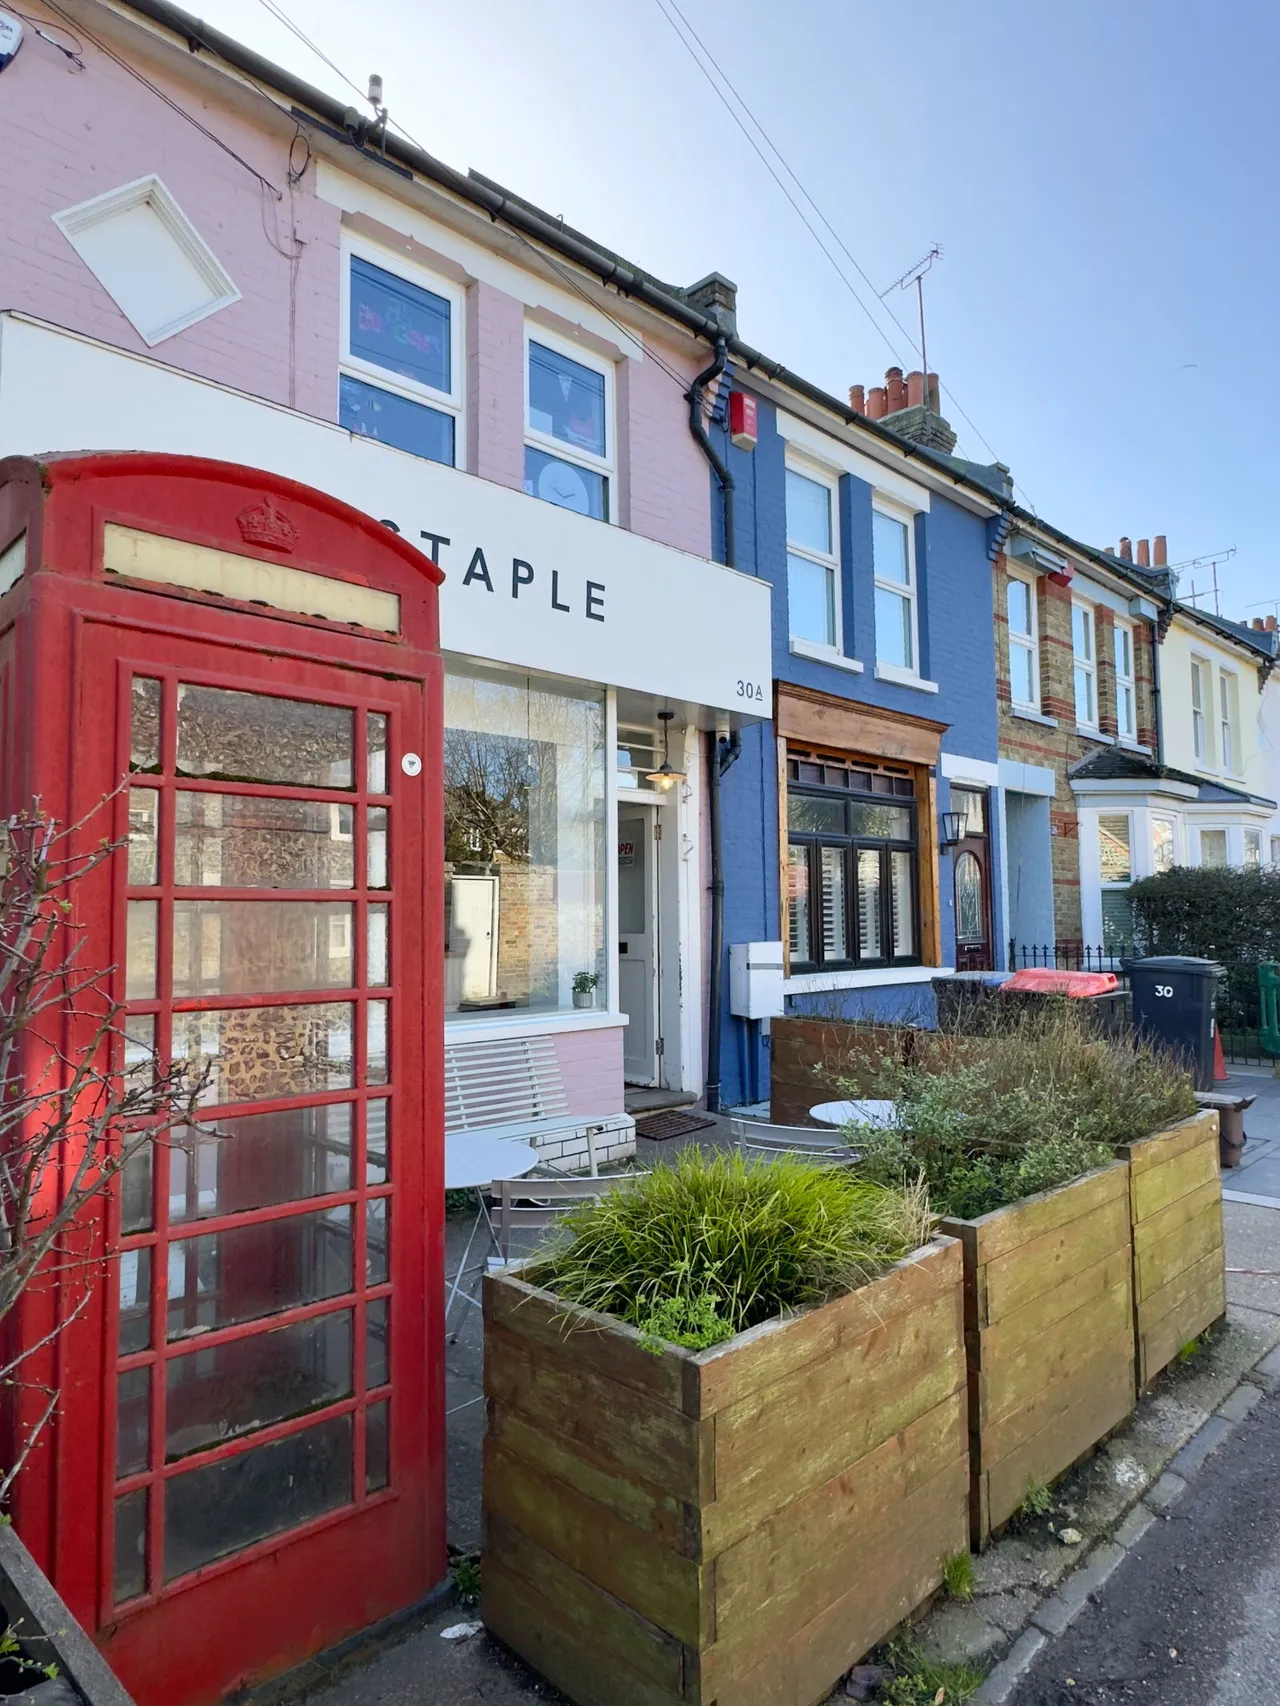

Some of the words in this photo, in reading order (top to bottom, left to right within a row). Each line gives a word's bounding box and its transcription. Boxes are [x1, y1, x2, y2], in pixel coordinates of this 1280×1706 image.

[380, 519, 606, 622] TAPLE
[737, 680, 763, 701] 30A
[618, 842, 635, 855] PEN
[1155, 985, 1173, 998] 30
